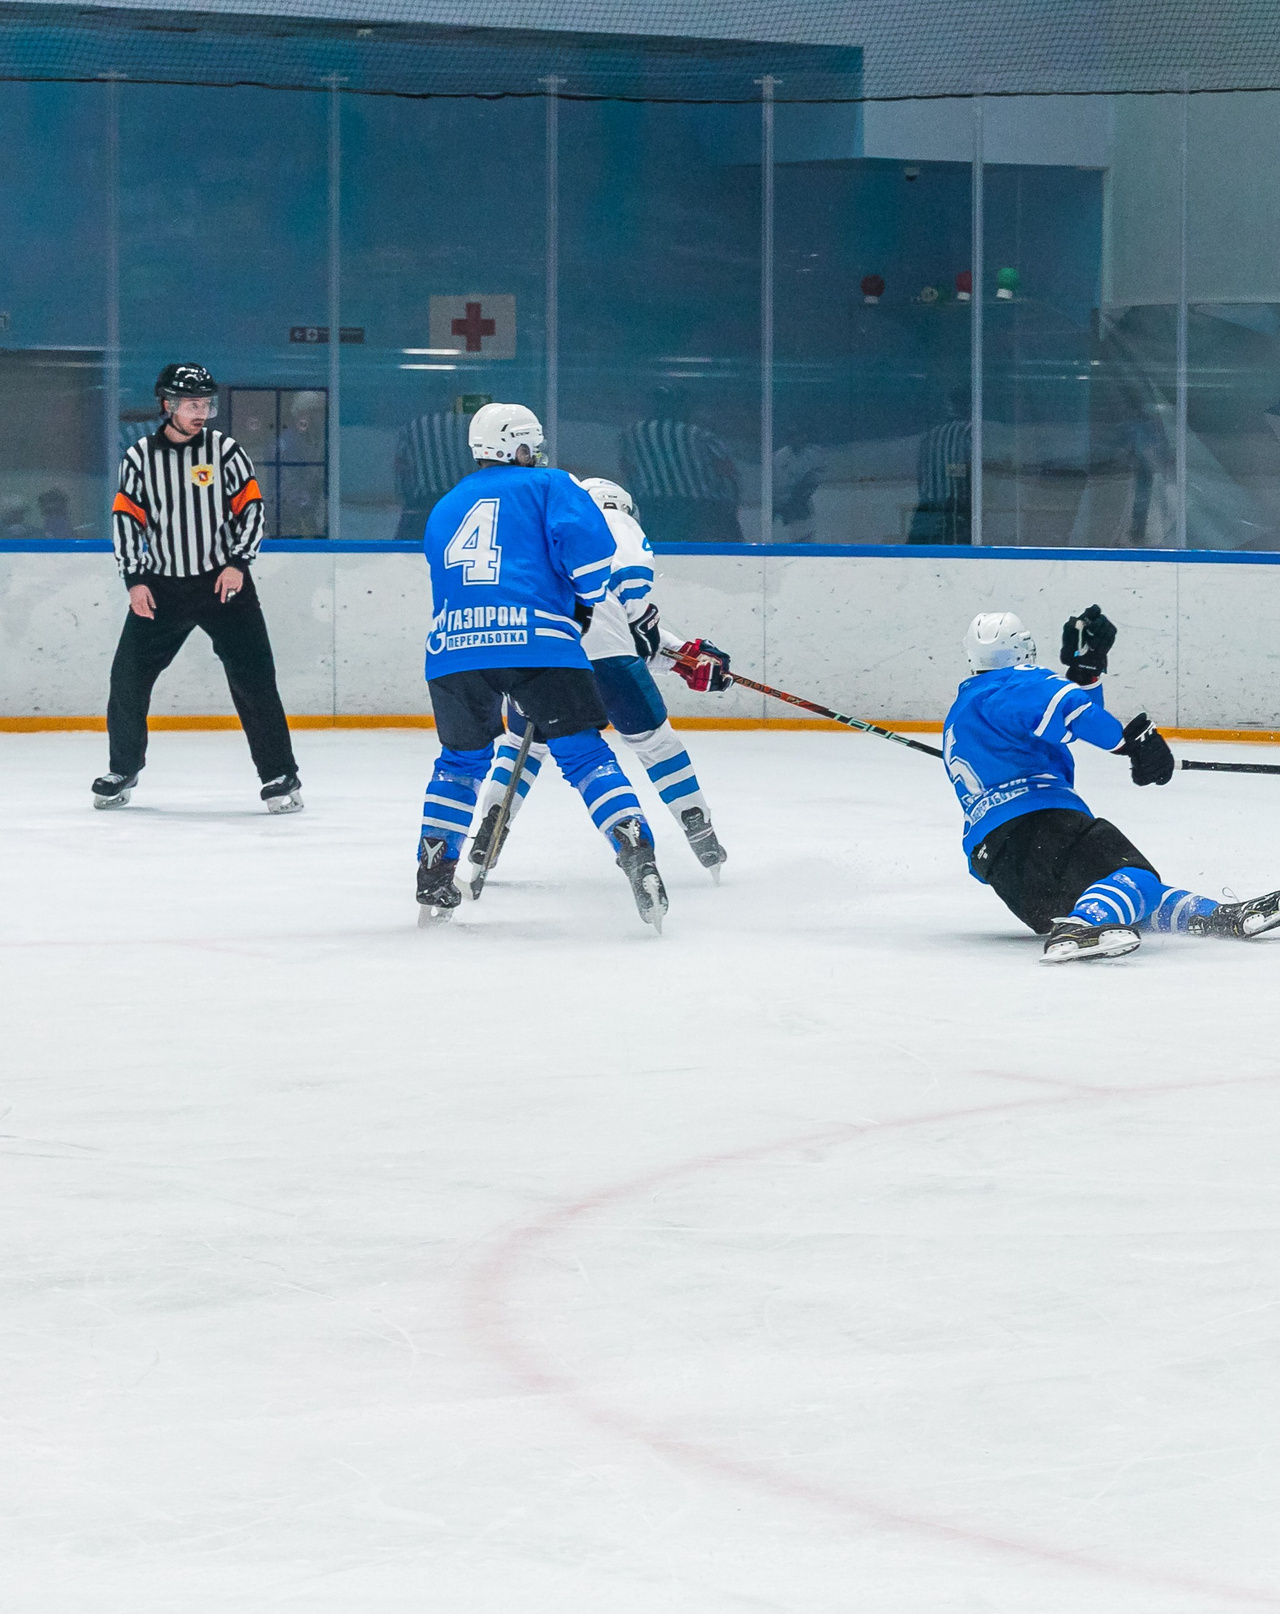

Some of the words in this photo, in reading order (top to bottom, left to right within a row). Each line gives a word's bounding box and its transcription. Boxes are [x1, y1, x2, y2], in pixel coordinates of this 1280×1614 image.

[444, 498, 502, 586] 4
[447, 606, 528, 632] ГАЗПРОМ
[447, 631, 528, 649] ПЕРЕРАБОТКА
